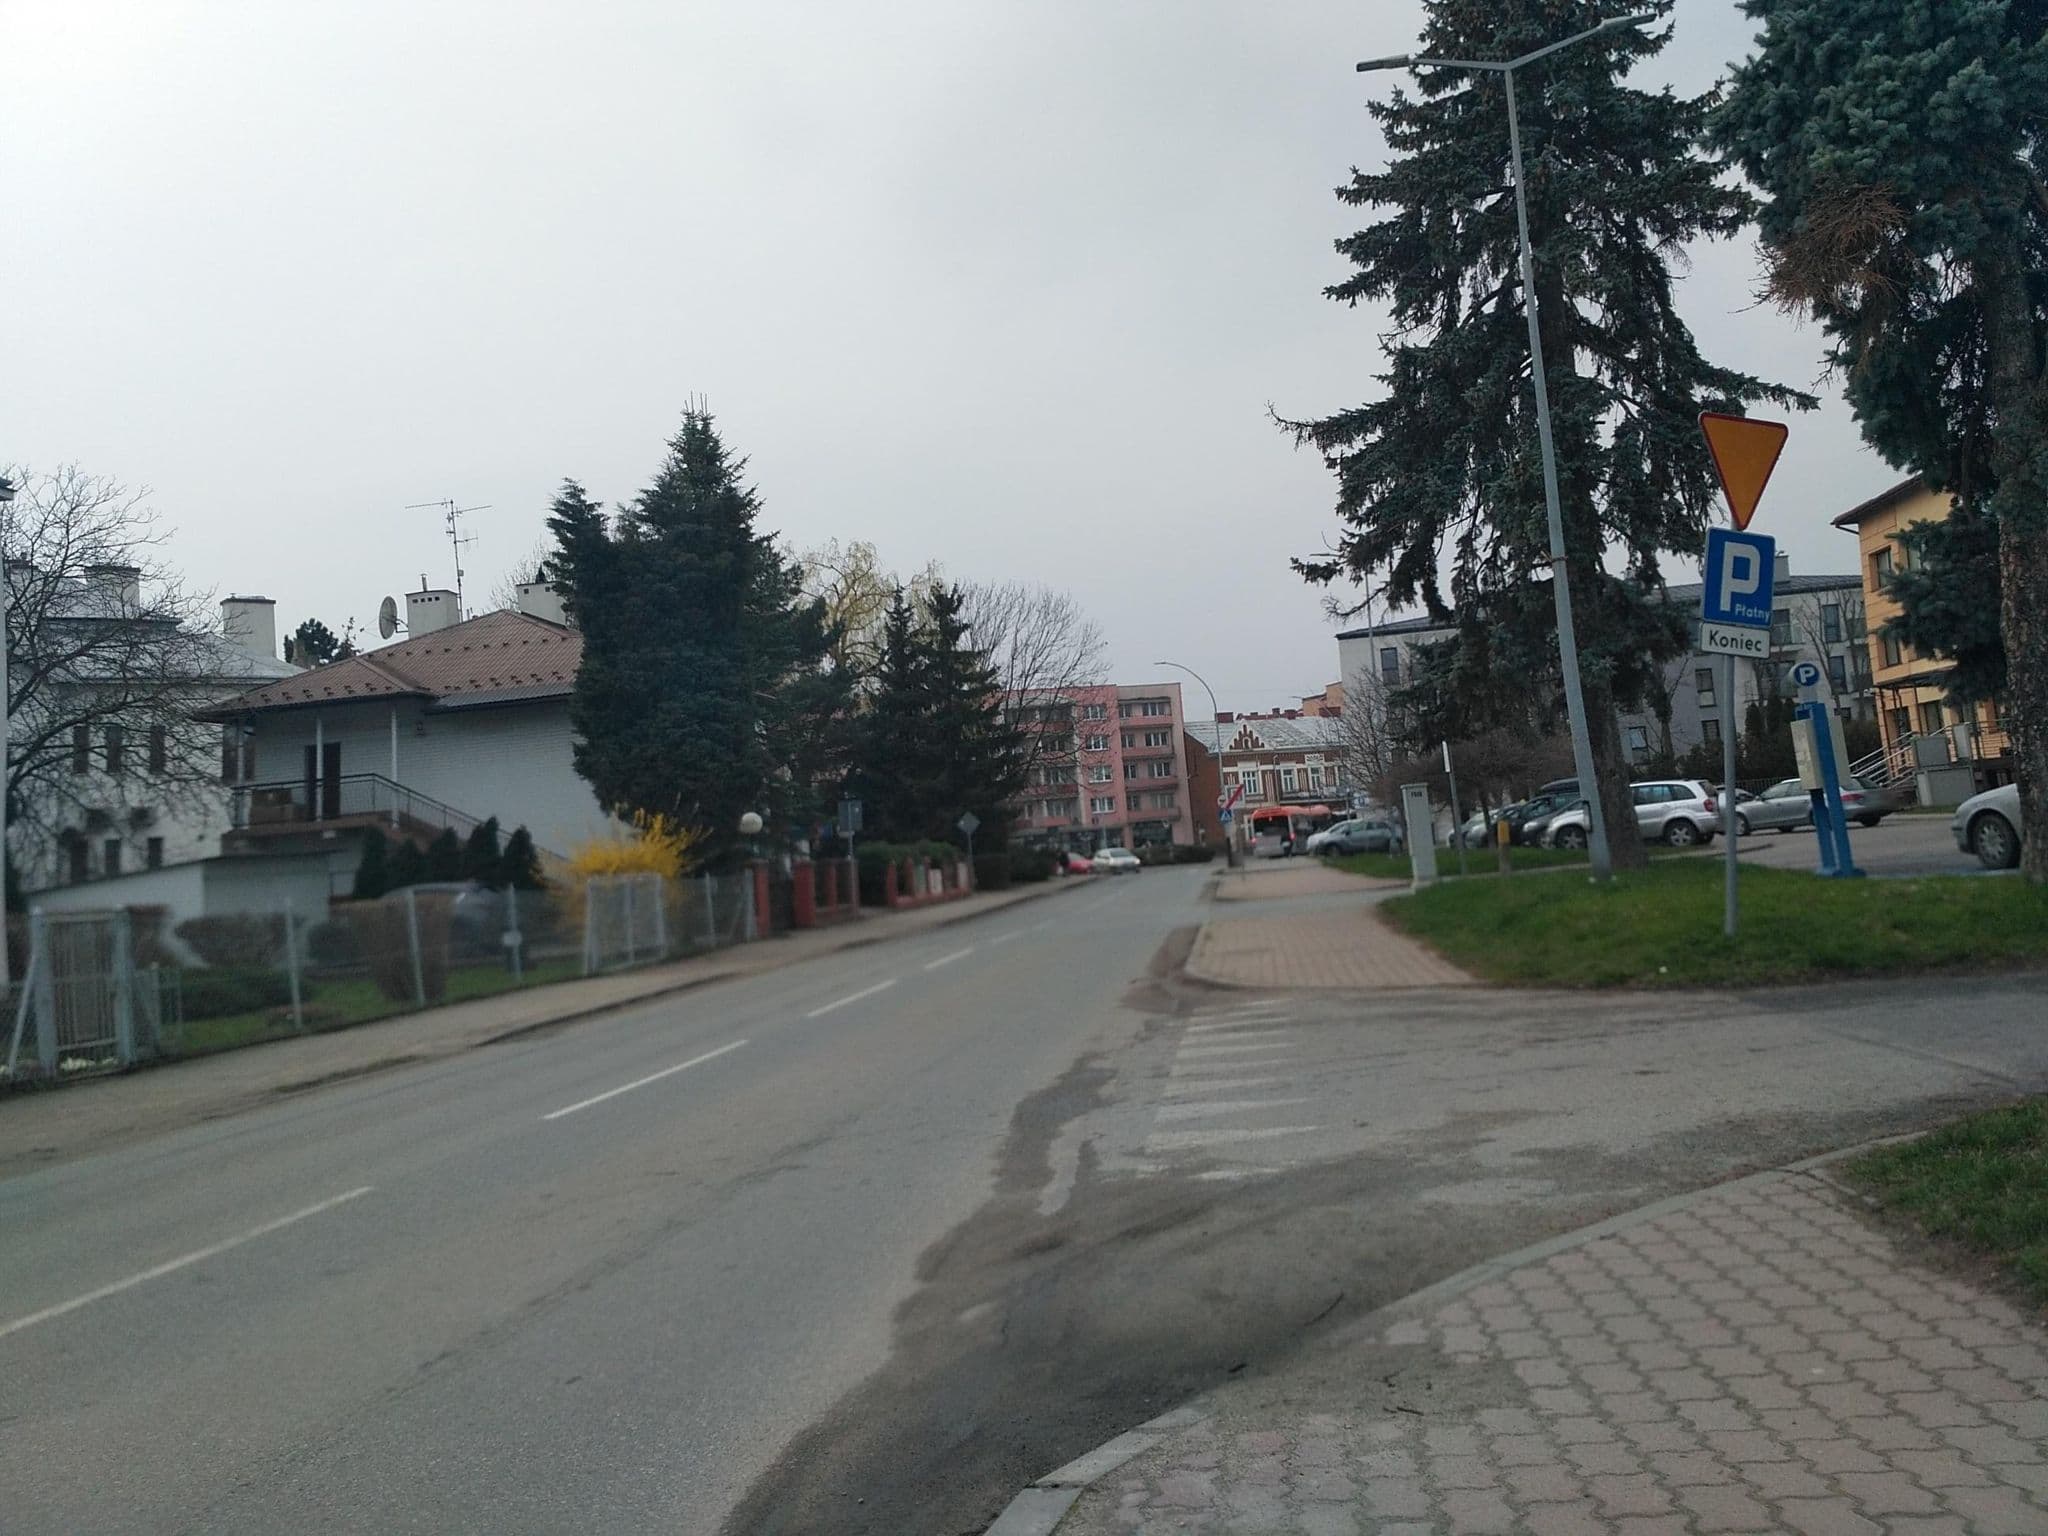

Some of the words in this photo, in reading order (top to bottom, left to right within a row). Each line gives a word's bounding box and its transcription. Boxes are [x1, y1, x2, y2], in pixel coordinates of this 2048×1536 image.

[1719, 541, 1761, 612] P
[1735, 603, 1770, 623] Płatny
[1709, 630, 1762, 652] Koniec
[1800, 667, 1815, 684] P
